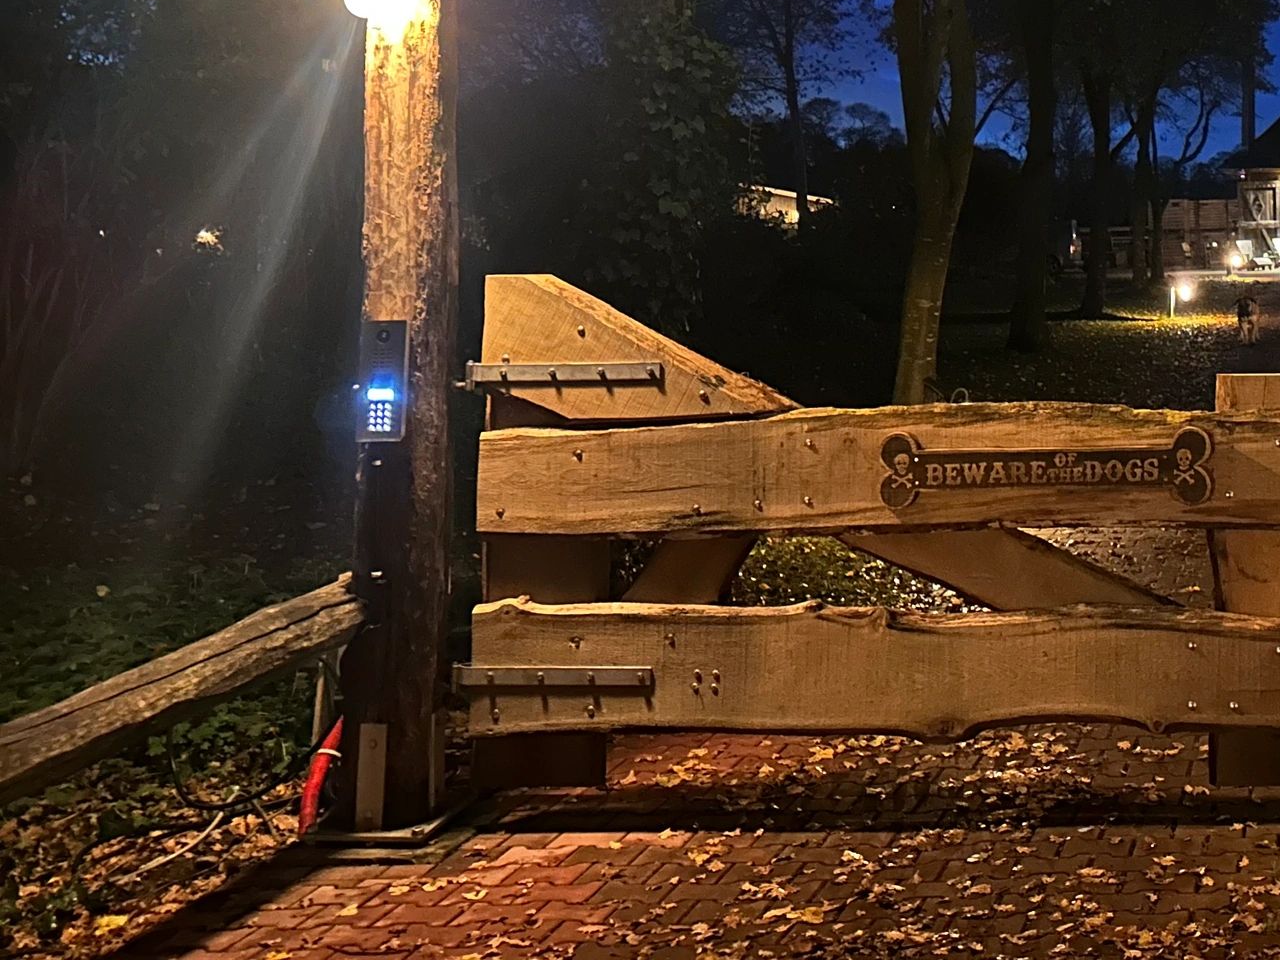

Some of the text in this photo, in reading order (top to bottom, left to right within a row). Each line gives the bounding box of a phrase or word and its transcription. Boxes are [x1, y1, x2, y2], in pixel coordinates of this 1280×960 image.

[926, 452, 1160, 486] BEWARE OF THE DOGS
